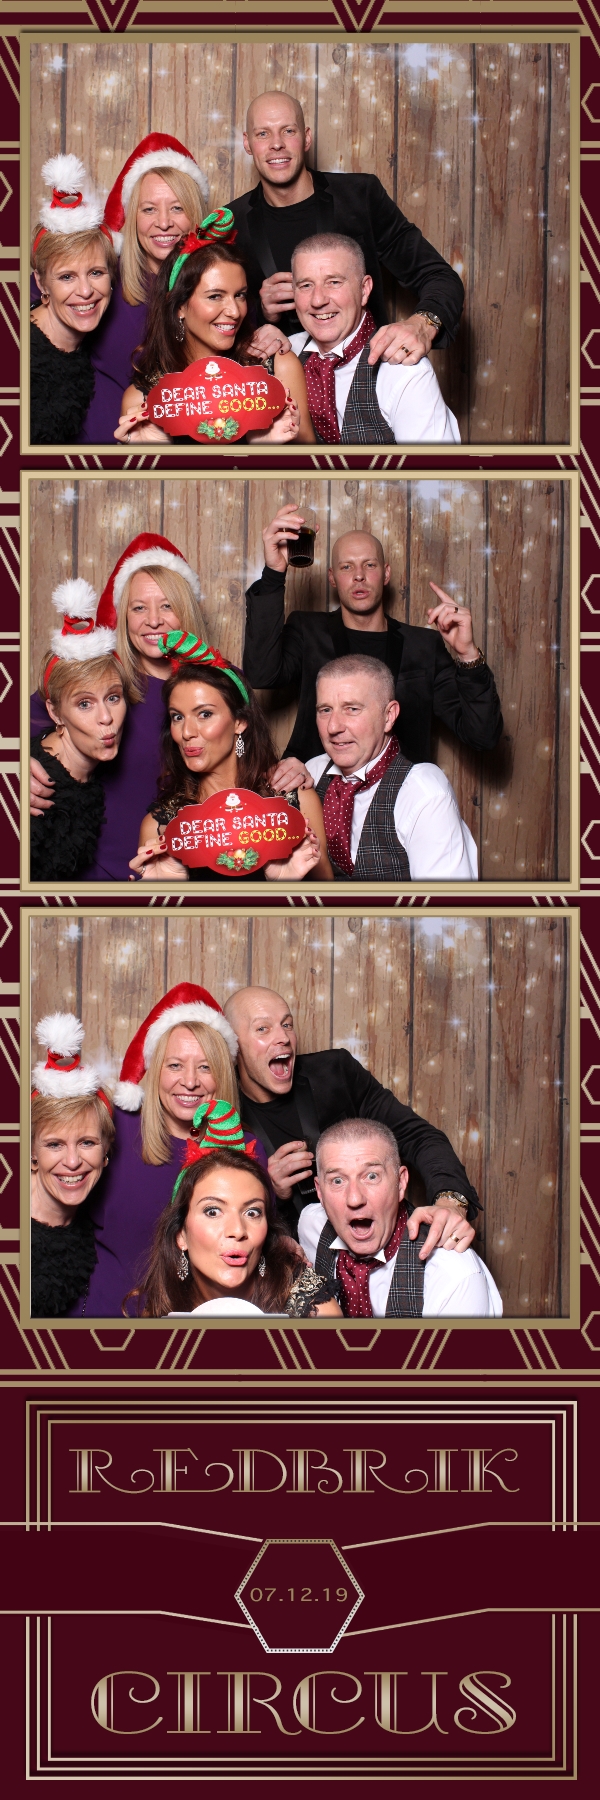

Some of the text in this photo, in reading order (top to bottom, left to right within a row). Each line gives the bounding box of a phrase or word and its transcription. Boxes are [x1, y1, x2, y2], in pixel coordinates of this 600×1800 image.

[161, 381, 269, 402] DEAR SANTA
[153, 397, 280, 418] DEFINE GOOD...
[179, 812, 289, 835] DEAR SANTA
[171, 827, 300, 851] DEFINE GOOD...
